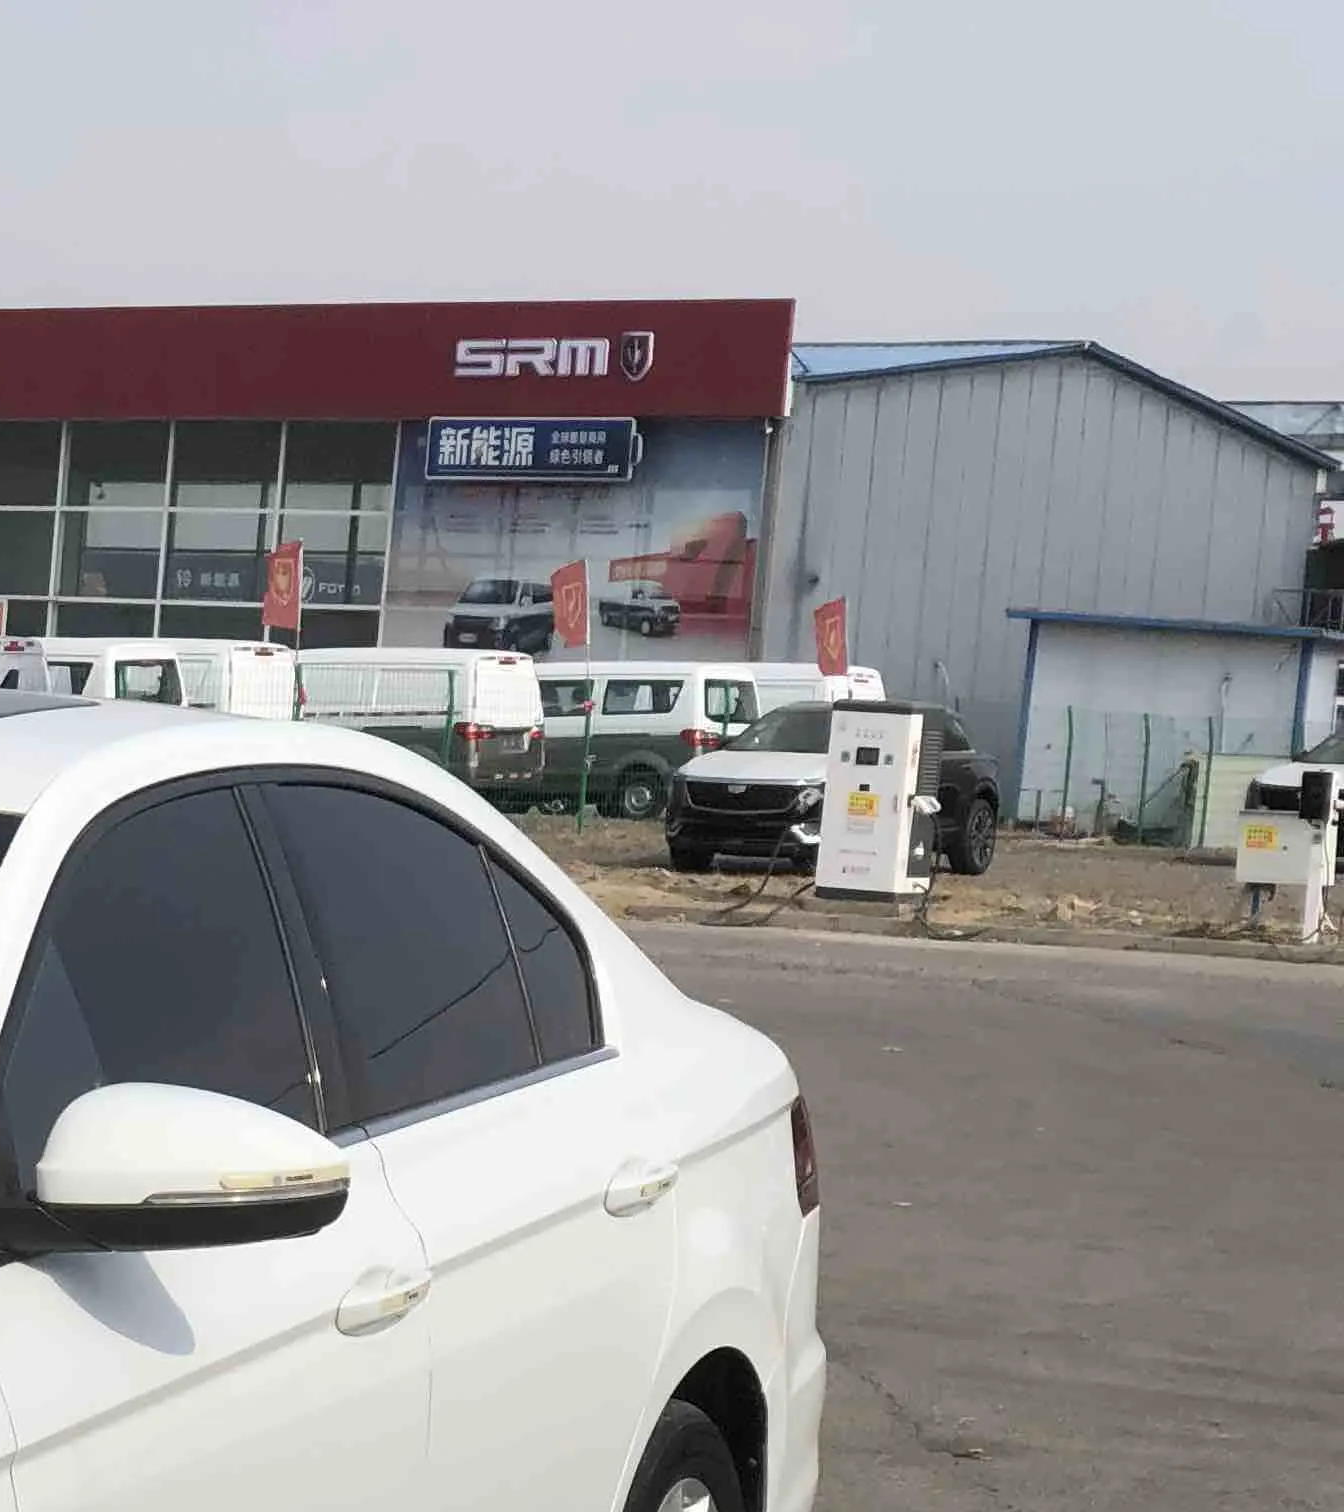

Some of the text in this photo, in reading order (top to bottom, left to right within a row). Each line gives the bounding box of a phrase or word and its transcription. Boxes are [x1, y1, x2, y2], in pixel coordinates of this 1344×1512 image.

[454, 337, 611, 377] SRM
[438, 426, 535, 466] 新能源
